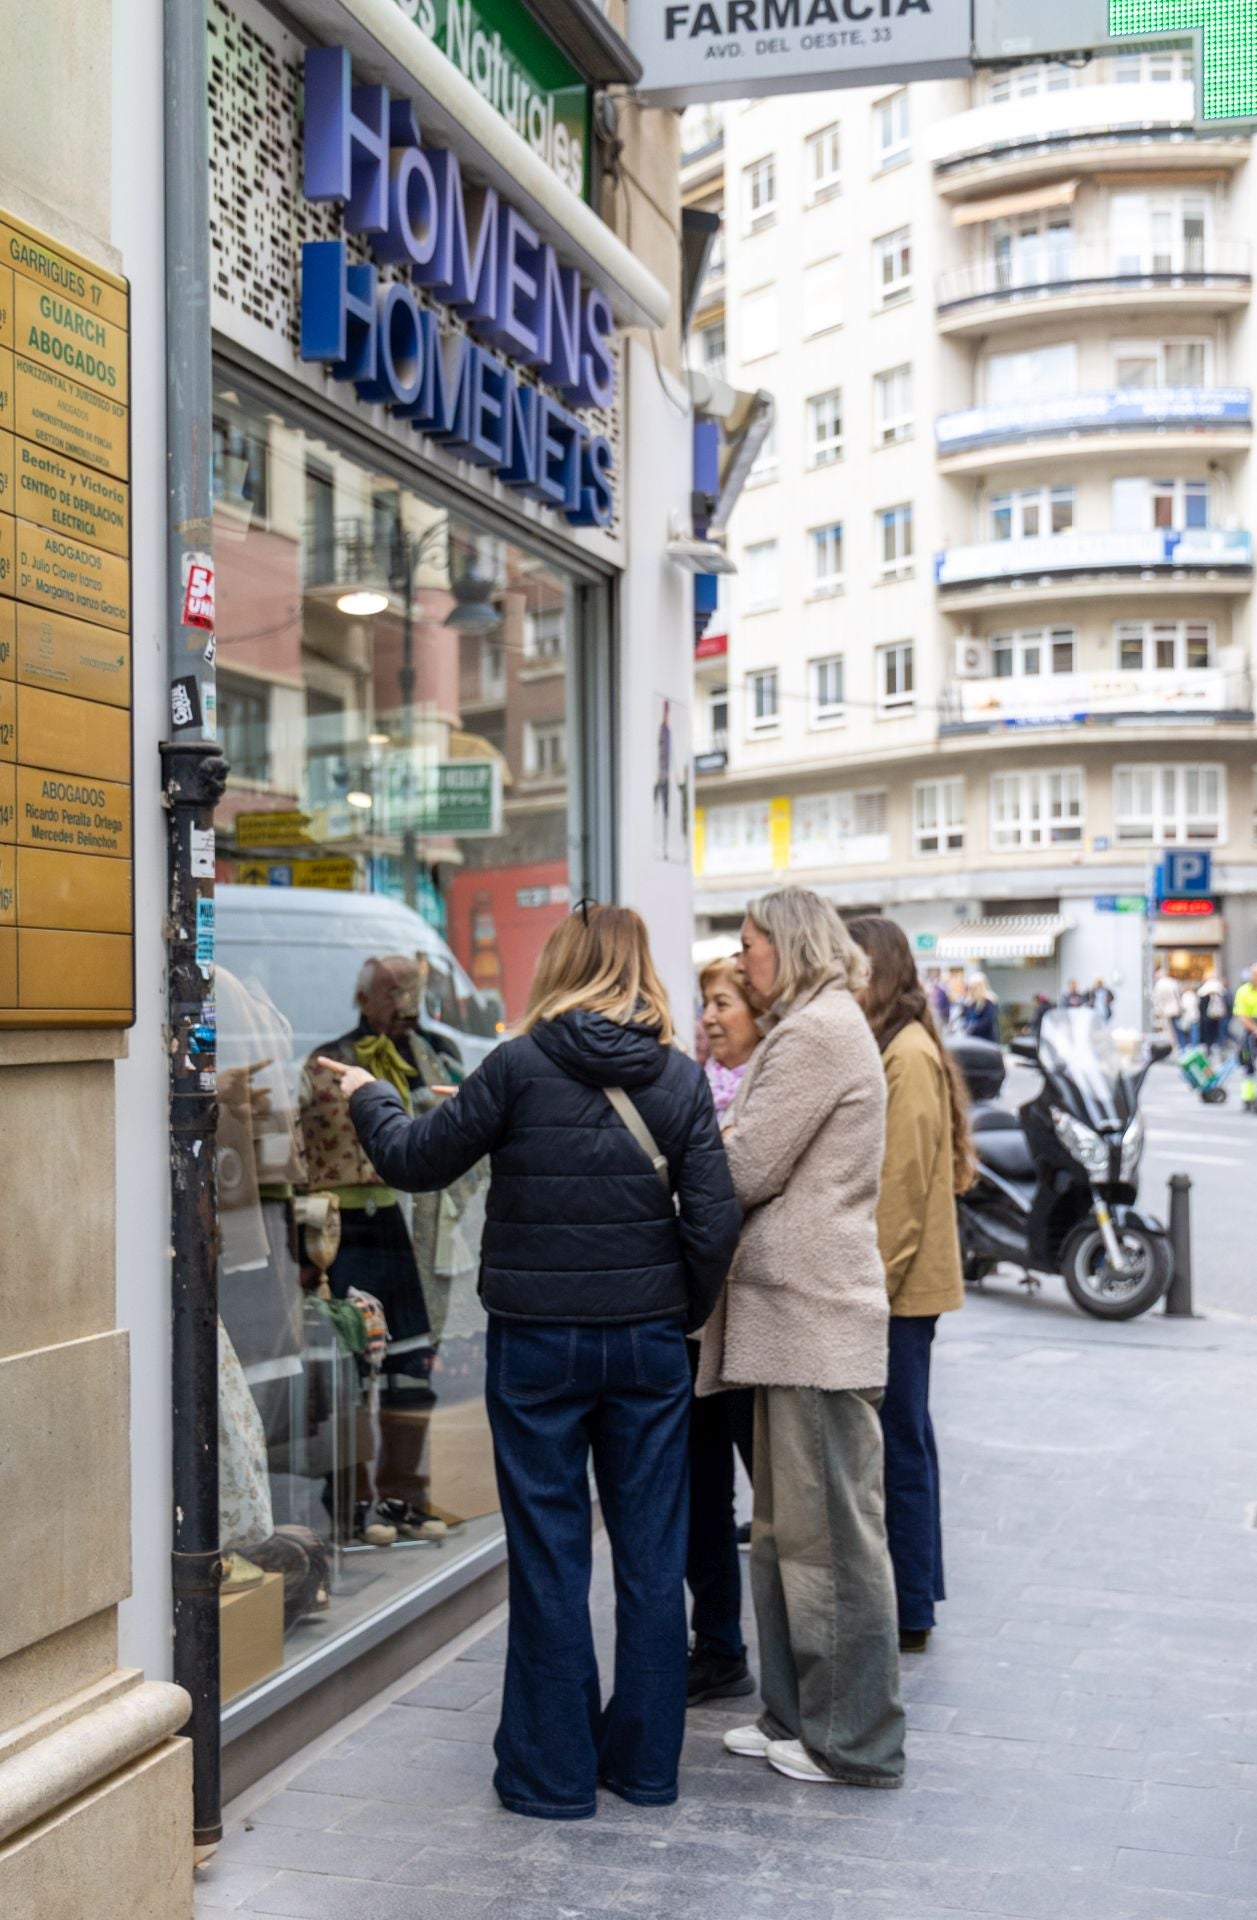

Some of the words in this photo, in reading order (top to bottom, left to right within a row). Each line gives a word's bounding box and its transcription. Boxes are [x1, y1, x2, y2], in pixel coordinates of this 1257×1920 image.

[705, 45, 744, 60] AVD.
[755, 39, 790, 55] DEL
[801, 30, 866, 51] OESTE,
[872, 27, 893, 43] 33
[446, 0, 583, 198] Naturales
[10, 238, 85, 298] GARRIGUES
[90, 284, 102, 306] 17
[40, 295, 106, 348] GUARCH
[28, 325, 117, 388] ABOGADOS
[16, 359, 67, 392] HORIZONTAL
[302, 240, 615, 528] HOMENETS
[22, 448, 66, 479] Beatriz
[70, 472, 77, 487] y
[80, 473, 124, 504] Victoria
[21, 474, 57, 500] CENTRO
[60, 490, 71, 506] DE
[73, 495, 124, 528] DEPILACION
[52, 508, 97, 537] ELECTRICA
[32, 556, 51, 574] Julio
[52, 563, 78, 583] Claver
[45, 538, 102, 569] ABOGADOS
[36, 578, 75, 602] Margarita
[42, 780, 106, 808] ABOGADOS
[26, 803, 59, 822] Ricardo
[62, 809, 92, 827] Peralta
[94, 814, 122, 834] Ortega
[32, 825, 74, 844] Mercedes
[1174, 855, 1203, 890] P
